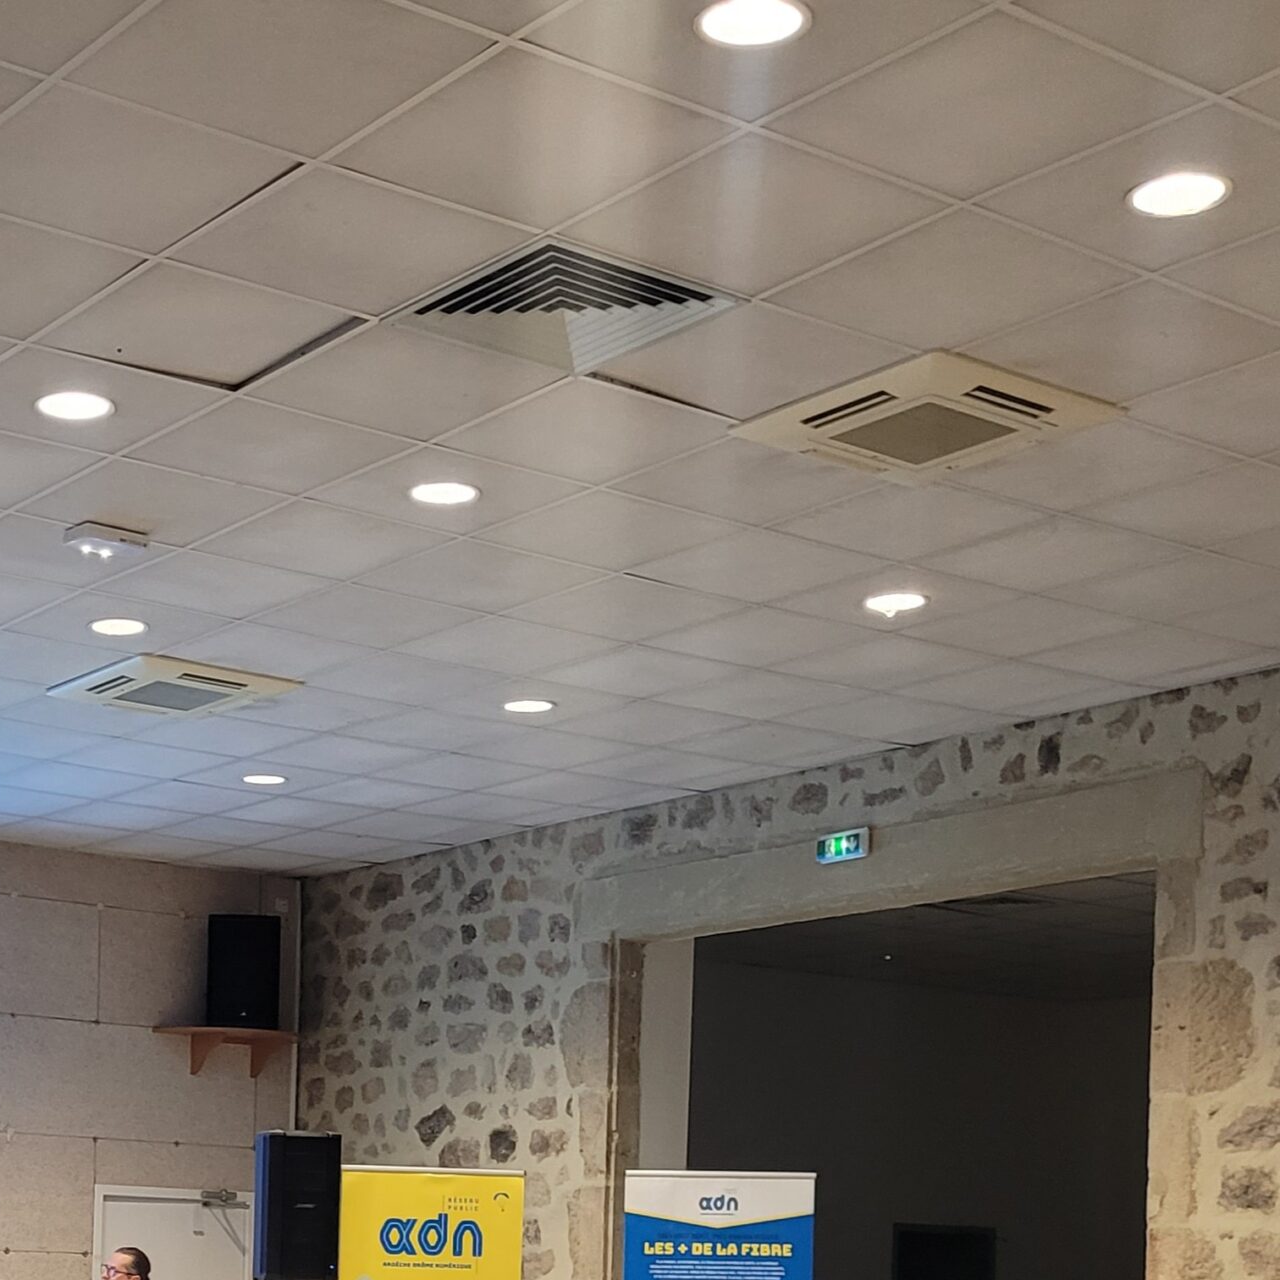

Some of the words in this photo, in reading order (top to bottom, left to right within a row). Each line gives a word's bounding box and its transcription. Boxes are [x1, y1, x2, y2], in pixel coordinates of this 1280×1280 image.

[699, 1194, 739, 1211] adn
[380, 1213, 483, 1257] adn
[644, 1242, 674, 1255] LES
[691, 1242, 712, 1256] DE
[716, 1243, 738, 1256] LA
[741, 1243, 793, 1257] FIBRE
